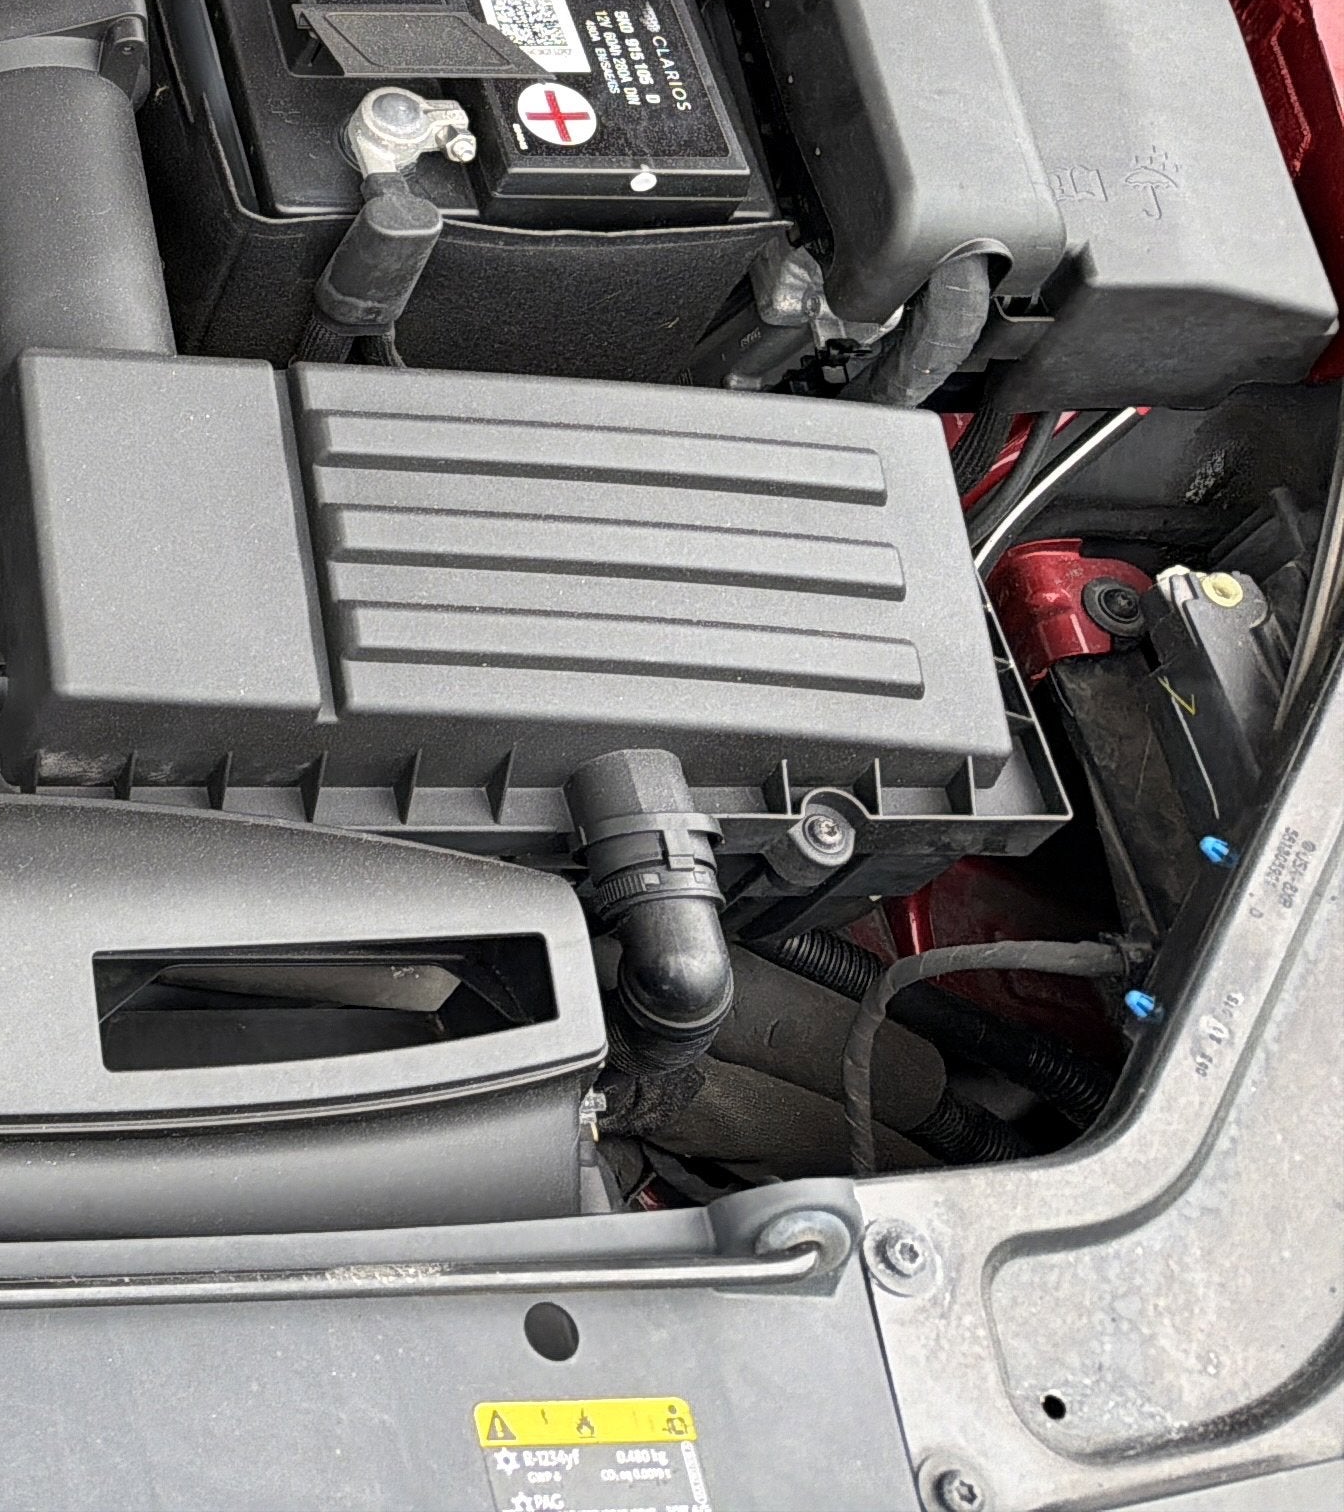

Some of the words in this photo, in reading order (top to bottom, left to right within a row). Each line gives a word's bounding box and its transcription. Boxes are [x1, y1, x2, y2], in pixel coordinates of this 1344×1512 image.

[595, 10, 611, 28] 12V
[603, 32, 622, 56] 60Ah
[613, 57, 633, 83] 280A
[624, 87, 641, 106] DIN
[625, 38, 645, 61] 915
[635, 63, 654, 85] 105
[645, 94, 660, 104] D
[652, 36, 691, 111] CLARIOS
[523, 1448, 579, 1470] R-1234yf
